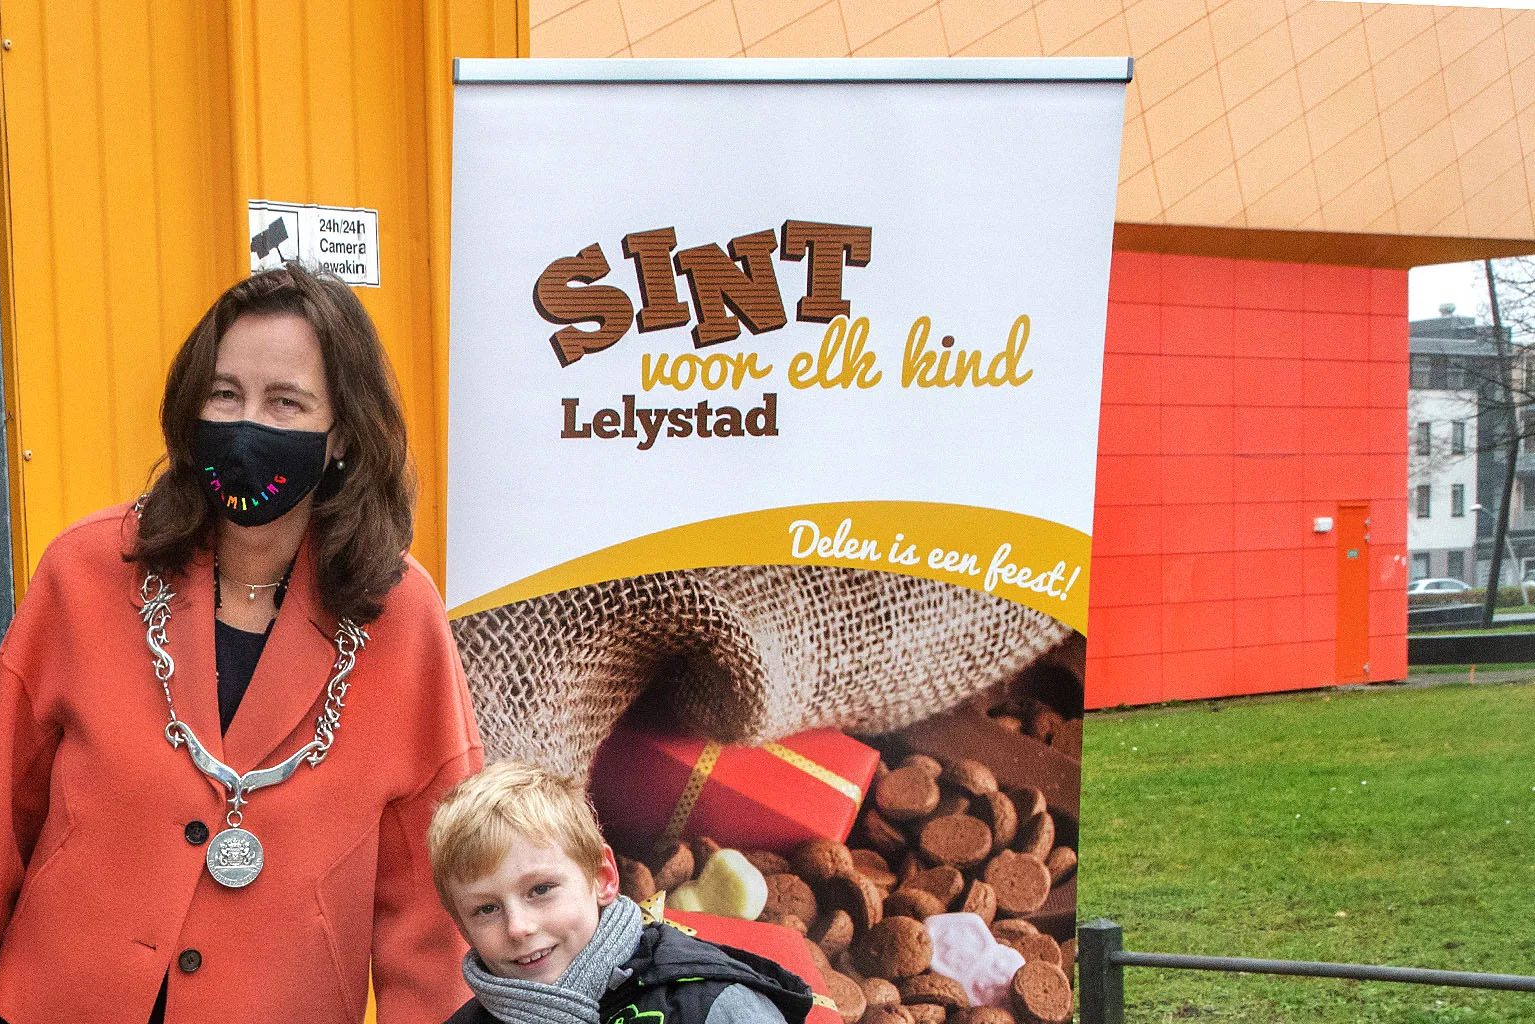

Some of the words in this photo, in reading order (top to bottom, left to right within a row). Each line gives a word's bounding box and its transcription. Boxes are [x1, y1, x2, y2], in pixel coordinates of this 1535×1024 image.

[319, 238, 366, 254] Camera
[320, 218, 366, 234] 24h/24h
[319, 260, 366, 274] ewakin
[532, 219, 872, 368] SINT
[641, 348, 772, 392] voor
[787, 317, 883, 390] elk
[900, 314, 1033, 389] kind
[561, 393, 779, 450] Lelystad
[788, 517, 882, 562] Delen
[888, 531, 922, 565] is
[928, 545, 981, 576] een
[983, 543, 1084, 601] feest!
